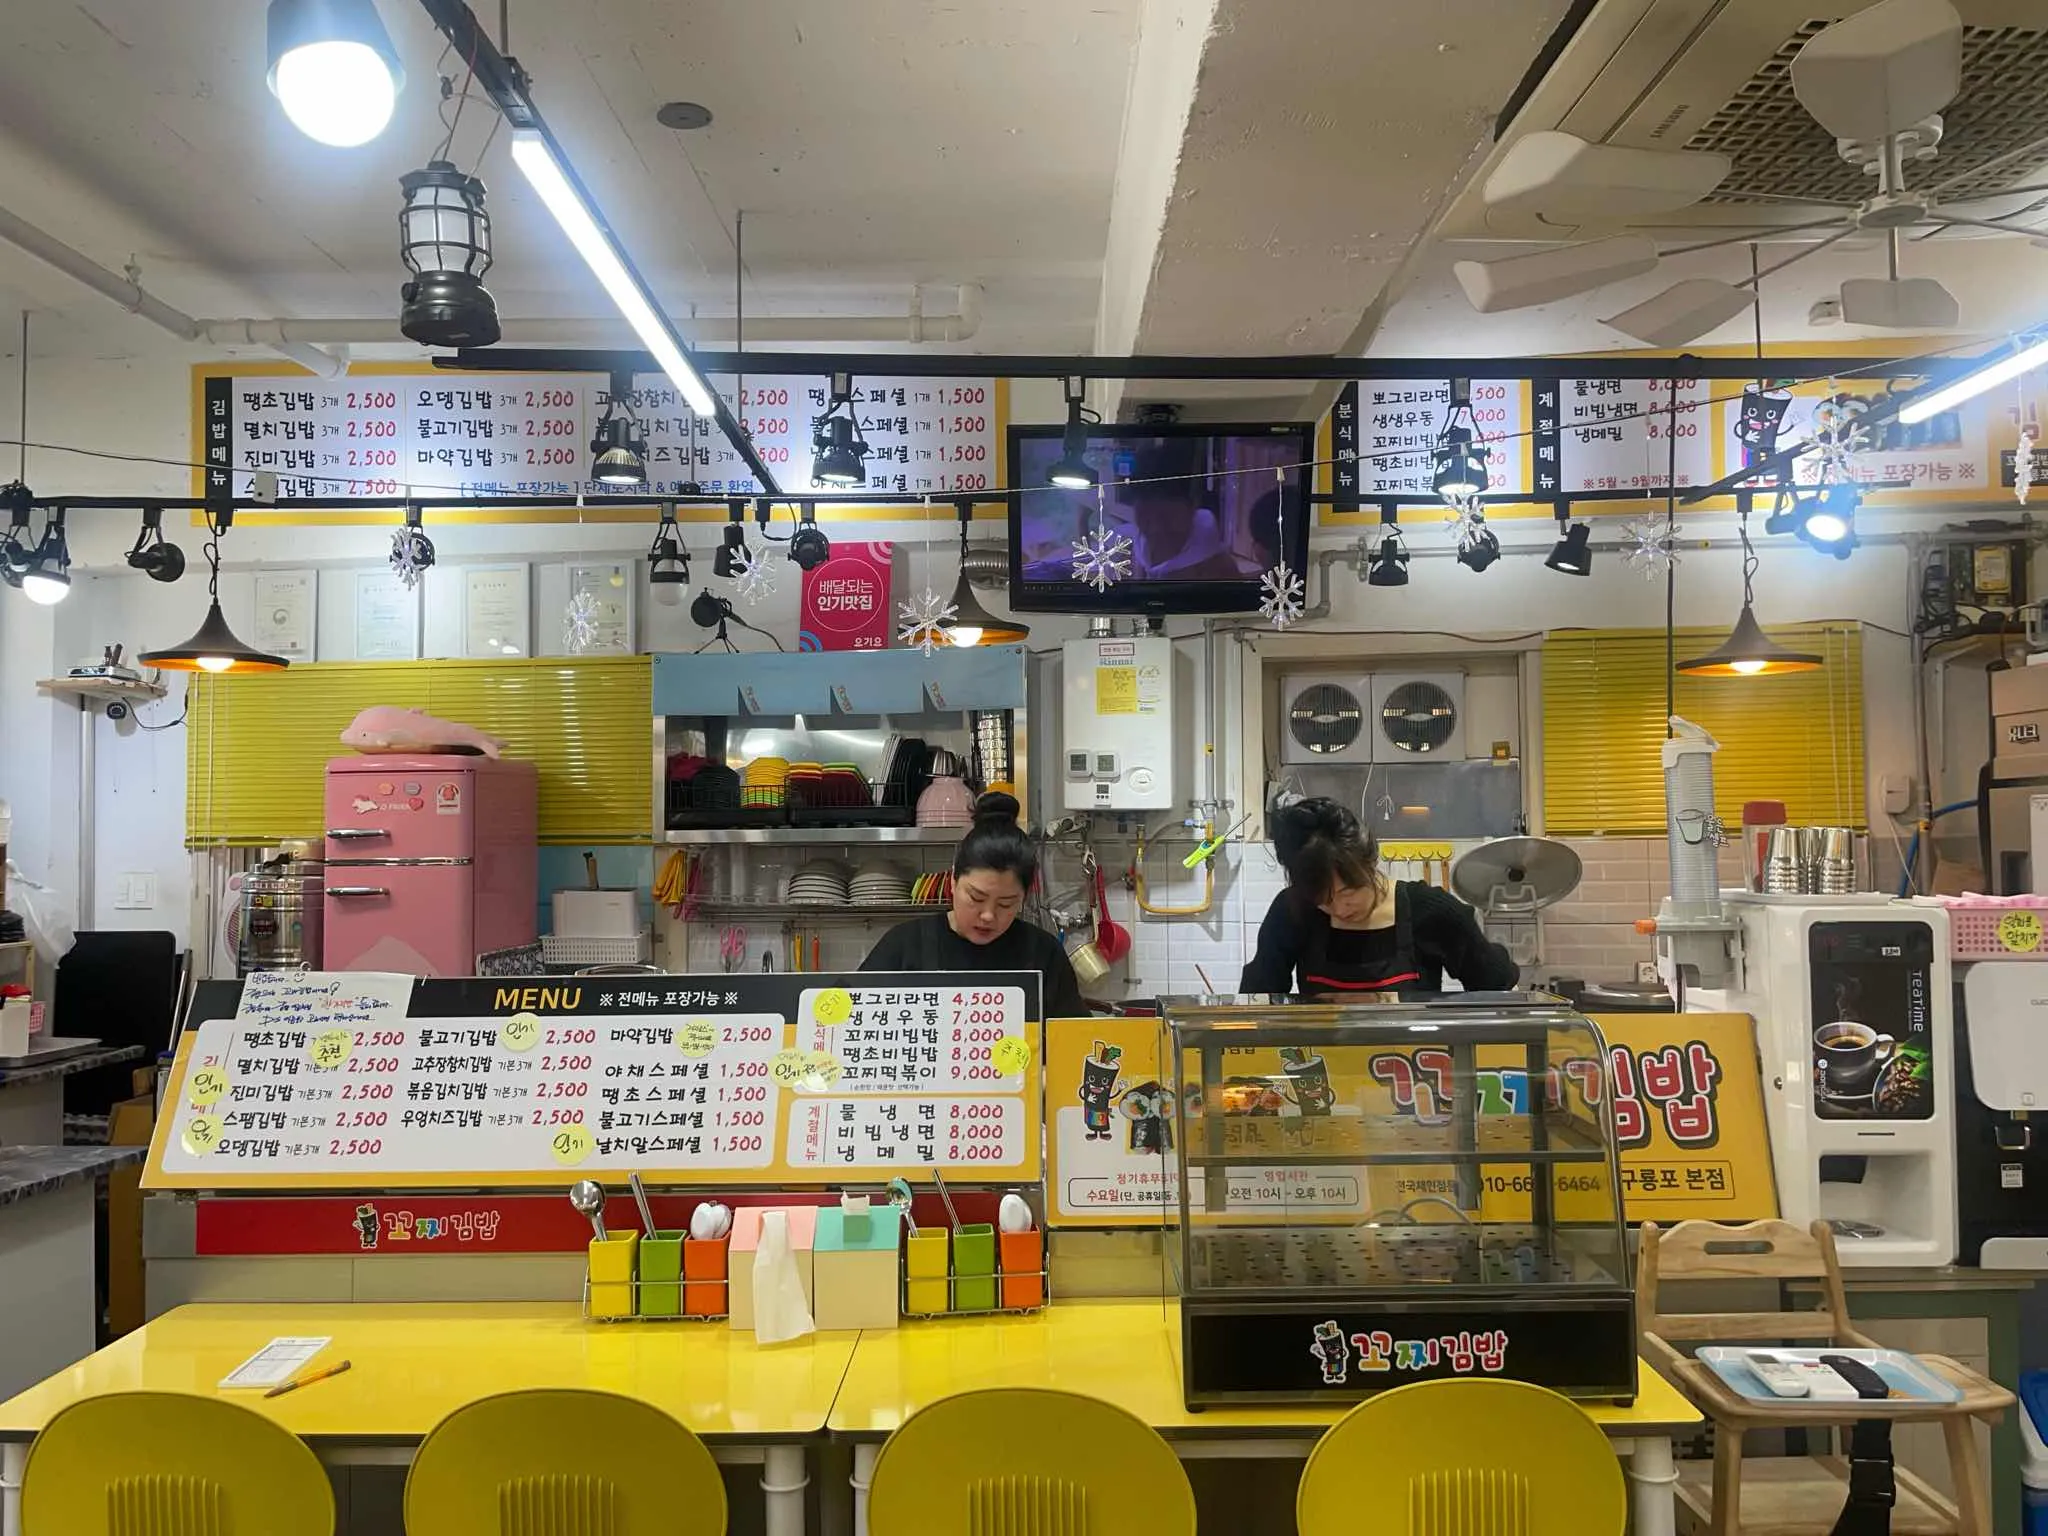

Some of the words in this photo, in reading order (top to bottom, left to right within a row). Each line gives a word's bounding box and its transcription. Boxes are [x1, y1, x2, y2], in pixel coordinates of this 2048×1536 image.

[243, 392, 315, 411] 땡초김밥
[347, 392, 396, 409] 2,500
[417, 390, 492, 410] 오뎅김밥
[525, 391, 574, 409] 2,500
[938, 388, 984, 405] 1,500
[1574, 402, 1638, 419] 비빔냉면
[418, 419, 493, 438] 불고기김밥
[526, 420, 574, 437] 2,500
[938, 417, 985, 435] 1,500
[1372, 411, 1434, 430] 생생우동
[244, 421, 315, 440] 멸치김밥
[347, 421, 396, 439] 2,500
[1575, 426, 1623, 444] 냉메밀
[211, 400, 227, 486] 김밥메뉴
[244, 450, 315, 469] 진미김밥
[348, 450, 396, 467] 2,500
[418, 448, 493, 467] 마약김밥
[526, 448, 574, 466] 2,500
[938, 446, 985, 463] 1,500
[244, 478, 315, 497] 스김밥
[939, 475, 986, 491] 1,500
[819, 579, 873, 595] 배달되는
[817, 595, 873, 611] 인기맛집
[853, 636, 883, 648] 요기요
[494, 988, 582, 1010] MENU
[617, 992, 660, 1008] 전메뉴
[663, 991, 720, 1007] 포장가능
[849, 992, 939, 1007] 뽀그리라면
[952, 992, 1005, 1007] 4,500
[952, 1010, 1005, 1026] 7,000
[243, 1032, 307, 1050] 땡초김밥
[353, 1031, 404, 1047] 2,500
[418, 1029, 497, 1046] 불고기김밥
[545, 1030, 596, 1045] 2,500
[610, 1028, 673, 1045] 마약김밥
[722, 1027, 772, 1043] 2,500
[844, 1028, 939, 1044] 꼬찌비빔밥
[951, 1028, 1005, 1044] 8,000
[843, 1047, 938, 1063] 땡초비빔밥
[951, 1046, 992, 1063] 8,00
[237, 1057, 300, 1075] 멸치김밥
[347, 1057, 399, 1073] 2,500
[411, 1056, 493, 1073] 고추장참치김밥
[540, 1055, 592, 1071] 2,500
[605, 1062, 710, 1079] 야채스페셜
[720, 1062, 768, 1079] 1,500
[841, 1064, 937, 1081] 꼬찌떡볶이
[230, 1085, 293, 1102] 진미김밥
[341, 1084, 394, 1100] 2,500
[407, 1081, 488, 1100] 볶음김치김밥
[536, 1082, 588, 1098] 2,500
[602, 1086, 707, 1104] 땡초스페셜
[717, 1086, 767, 1102] 1,500
[223, 1111, 287, 1129] 스팸김밥
[335, 1112, 388, 1128] 2,500
[401, 1109, 483, 1128] 우엉치즈김밥
[532, 1109, 585, 1125] 2,500
[599, 1110, 704, 1129] 불고기스페셜
[714, 1111, 764, 1128] 1,500
[949, 1104, 1003, 1120] 8,000
[949, 1124, 1003, 1141] 8,000
[214, 1138, 281, 1158] 오뎅김밥
[328, 1138, 383, 1156] 2,500
[595, 1136, 701, 1155] 날치알스페셜
[711, 1135, 762, 1152] 1,500
[948, 1145, 1002, 1162] 8,000
[1264, 1170, 1308, 1182] 영업시간
[1621, 1169, 1679, 1191] 구룡포
[1686, 1169, 1725, 1191] 본점
[1230, 1187, 1252, 1200] 오전
[1256, 1187, 1281, 1200] 10시
[1294, 1186, 1317, 1200] 오후
[1321, 1187, 1346, 1200] 10시
[383, 1210, 501, 1241] 꼬찌김밥
[1350, 1331, 1508, 1373] 꼬찌김밥
